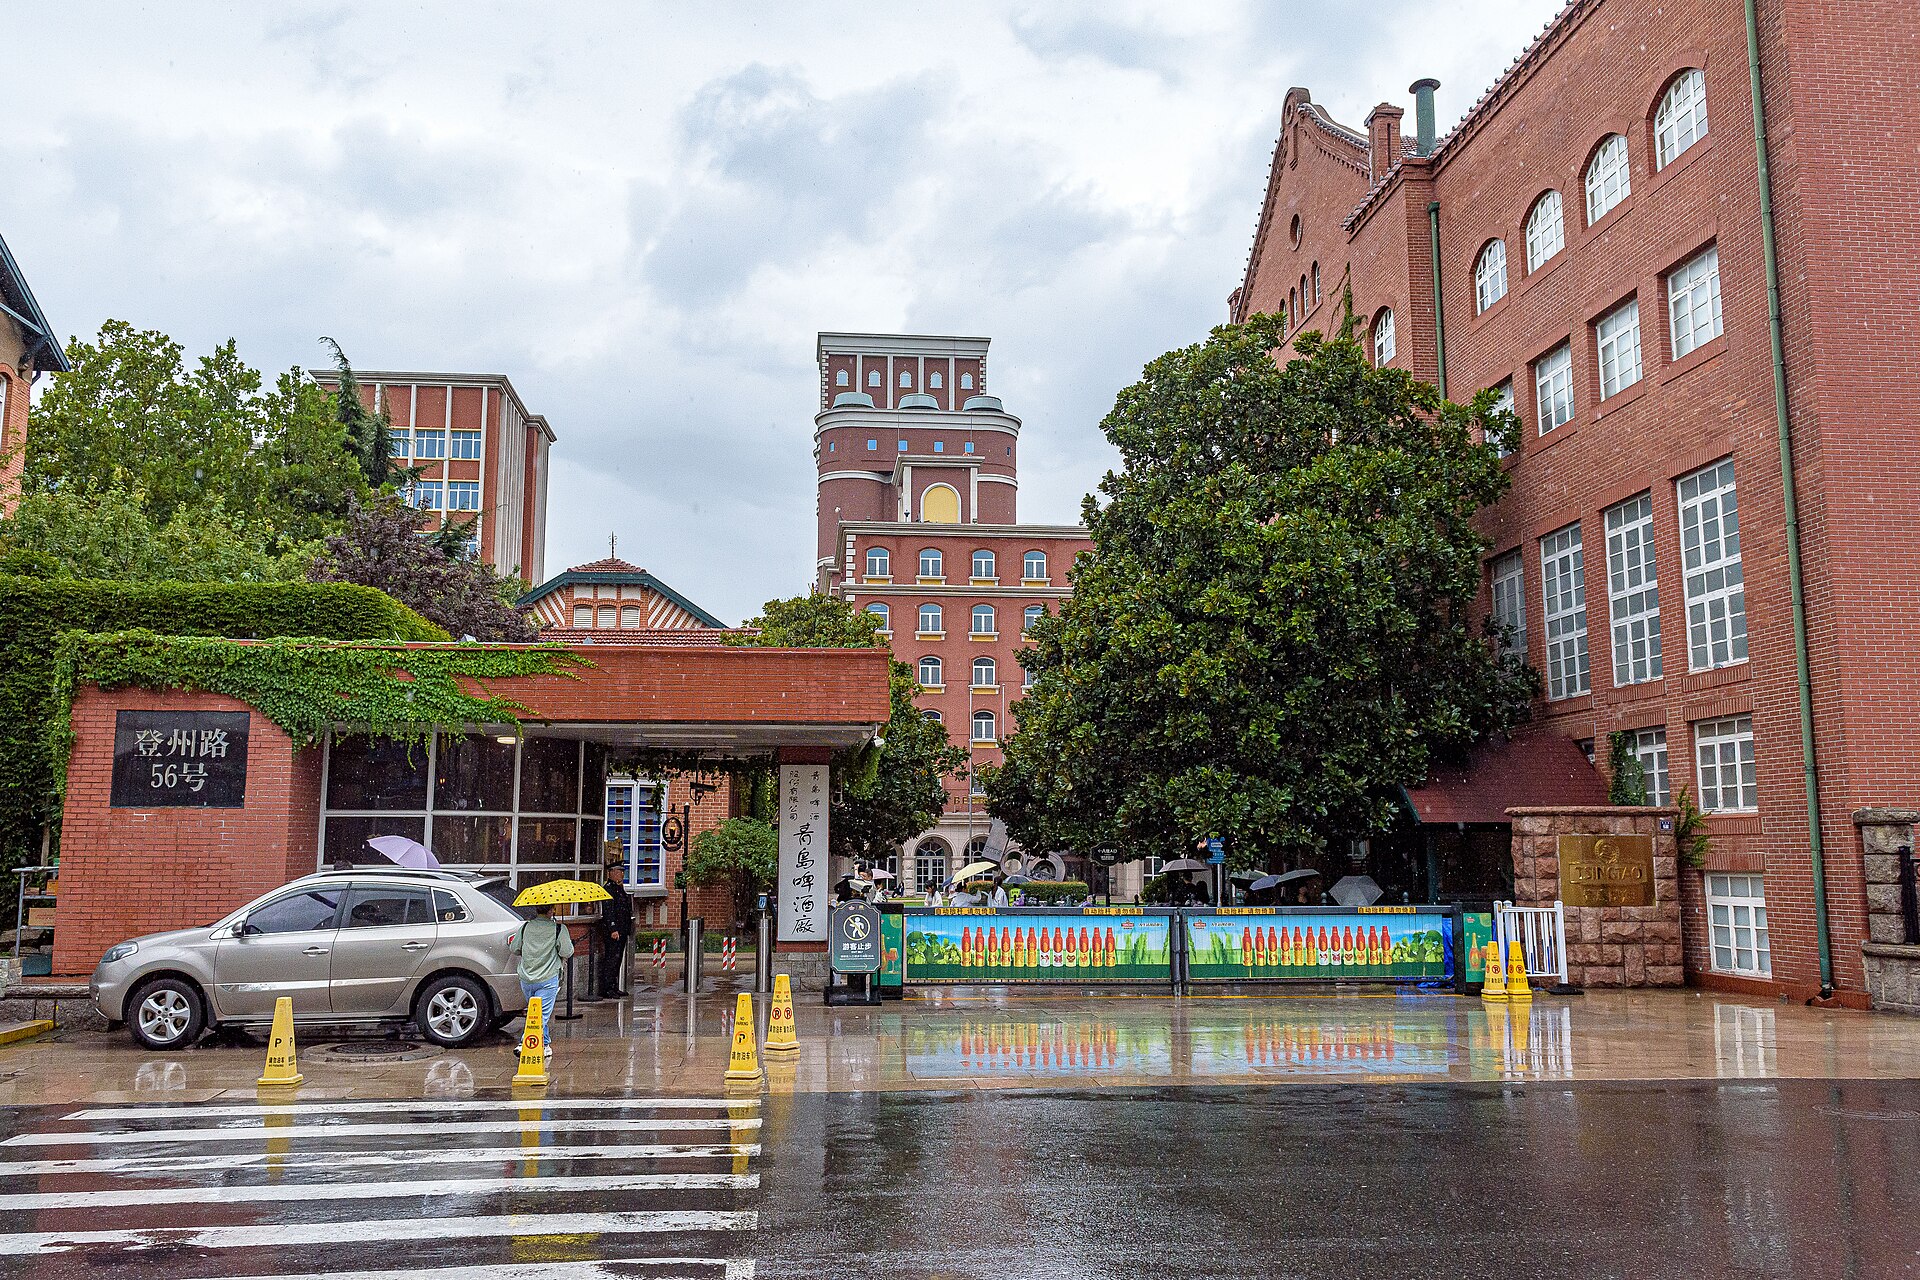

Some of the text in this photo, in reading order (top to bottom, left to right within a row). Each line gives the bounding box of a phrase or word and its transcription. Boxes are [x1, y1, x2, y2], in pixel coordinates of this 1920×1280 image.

[134, 728, 230, 758] 登州路
[150, 762, 209, 792] 56号
[1575, 865, 1643, 880] TSINGTAO
[842, 943, 872, 951] 游客止步
[521, 1056, 541, 1065] 请勿泊车
